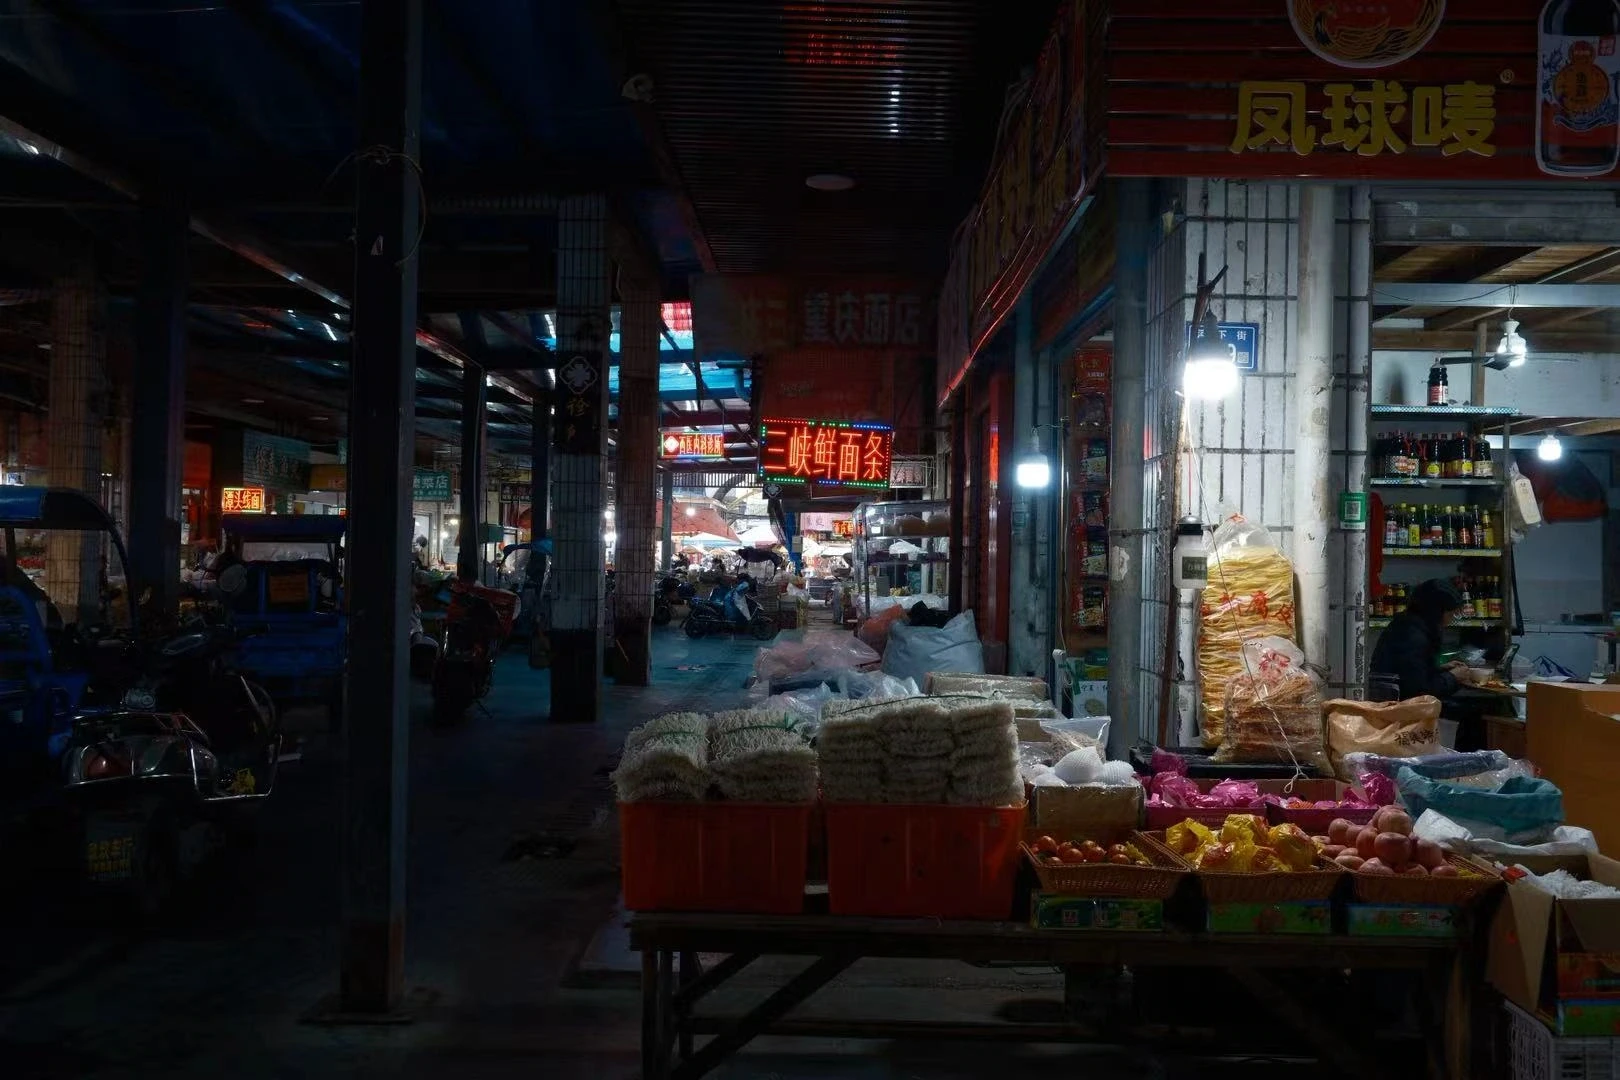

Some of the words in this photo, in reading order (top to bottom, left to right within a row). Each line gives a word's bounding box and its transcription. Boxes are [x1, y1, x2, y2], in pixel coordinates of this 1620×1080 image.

[1230, 80, 1497, 157] 凤球唛
[678, 434, 722, 455] 西医内科诊所
[763, 426, 885, 481] 三峡鲜面条
